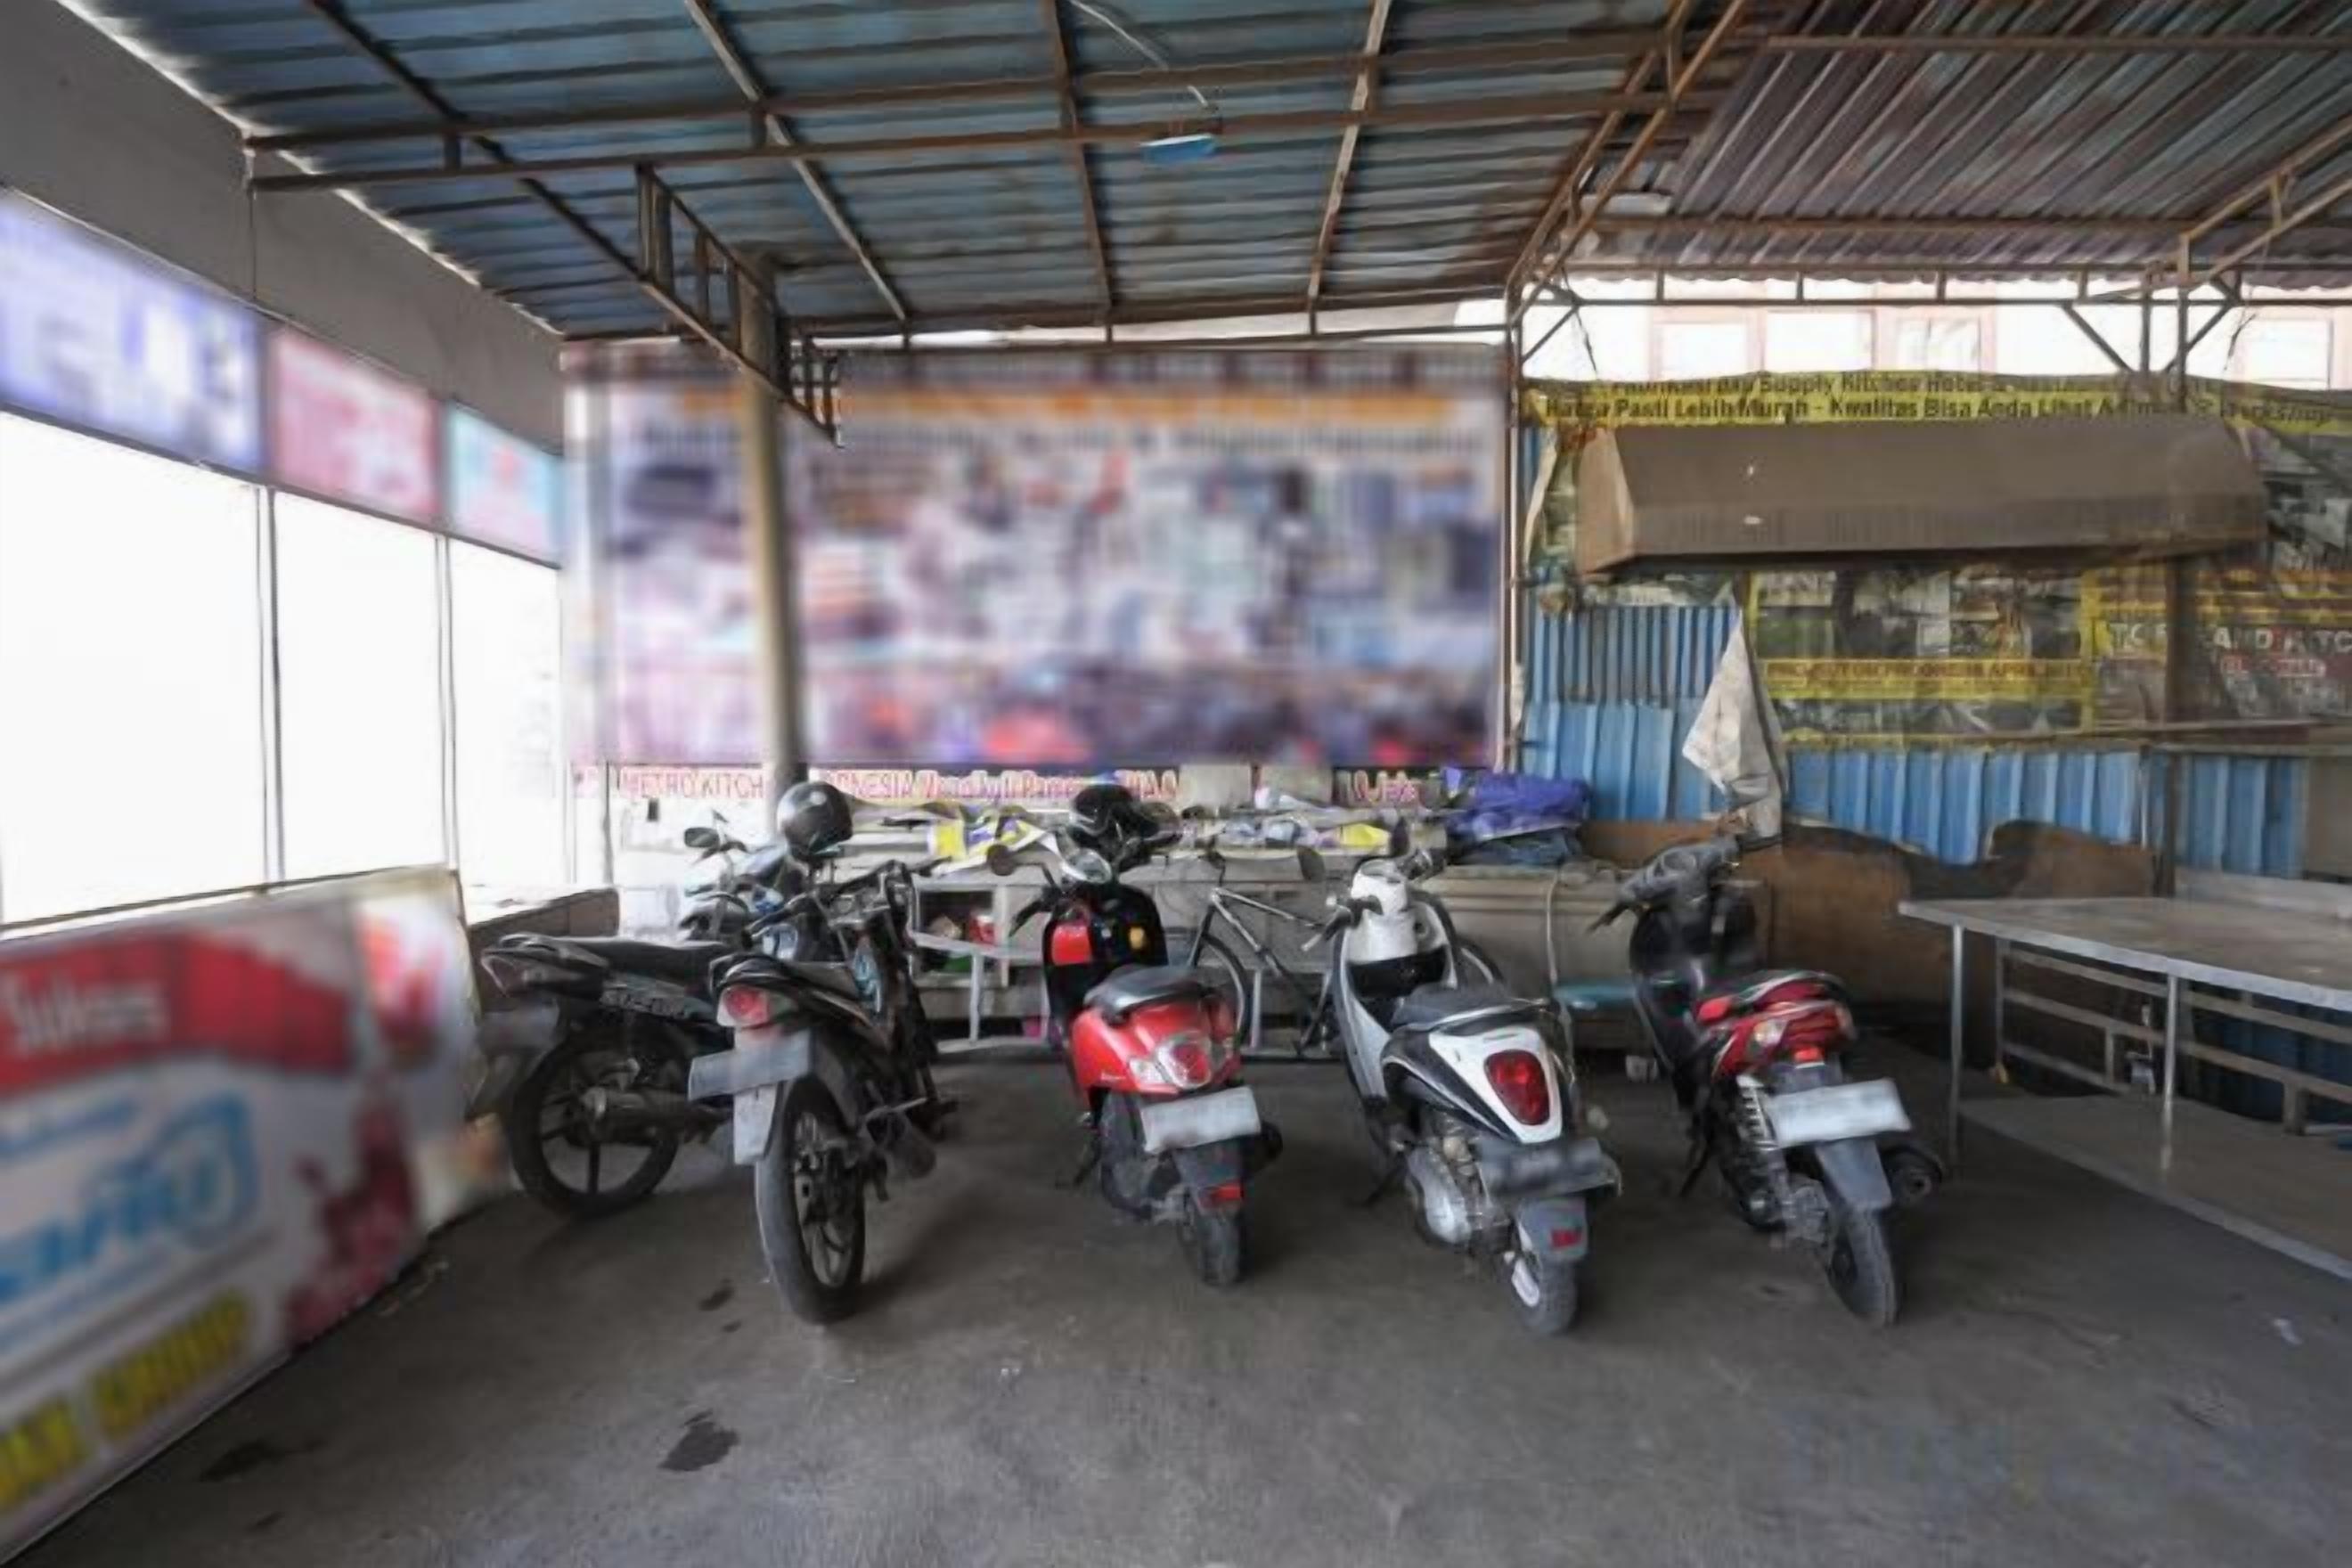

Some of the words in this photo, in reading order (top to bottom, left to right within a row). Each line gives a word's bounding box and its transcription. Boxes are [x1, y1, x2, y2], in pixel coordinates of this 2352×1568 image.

[1674, 397, 1733, 418] Lebih
[1830, 397, 1919, 417] Kwalitas
[1924, 397, 1971, 417] Bisa
[701, 772, 764, 799] KITCH
